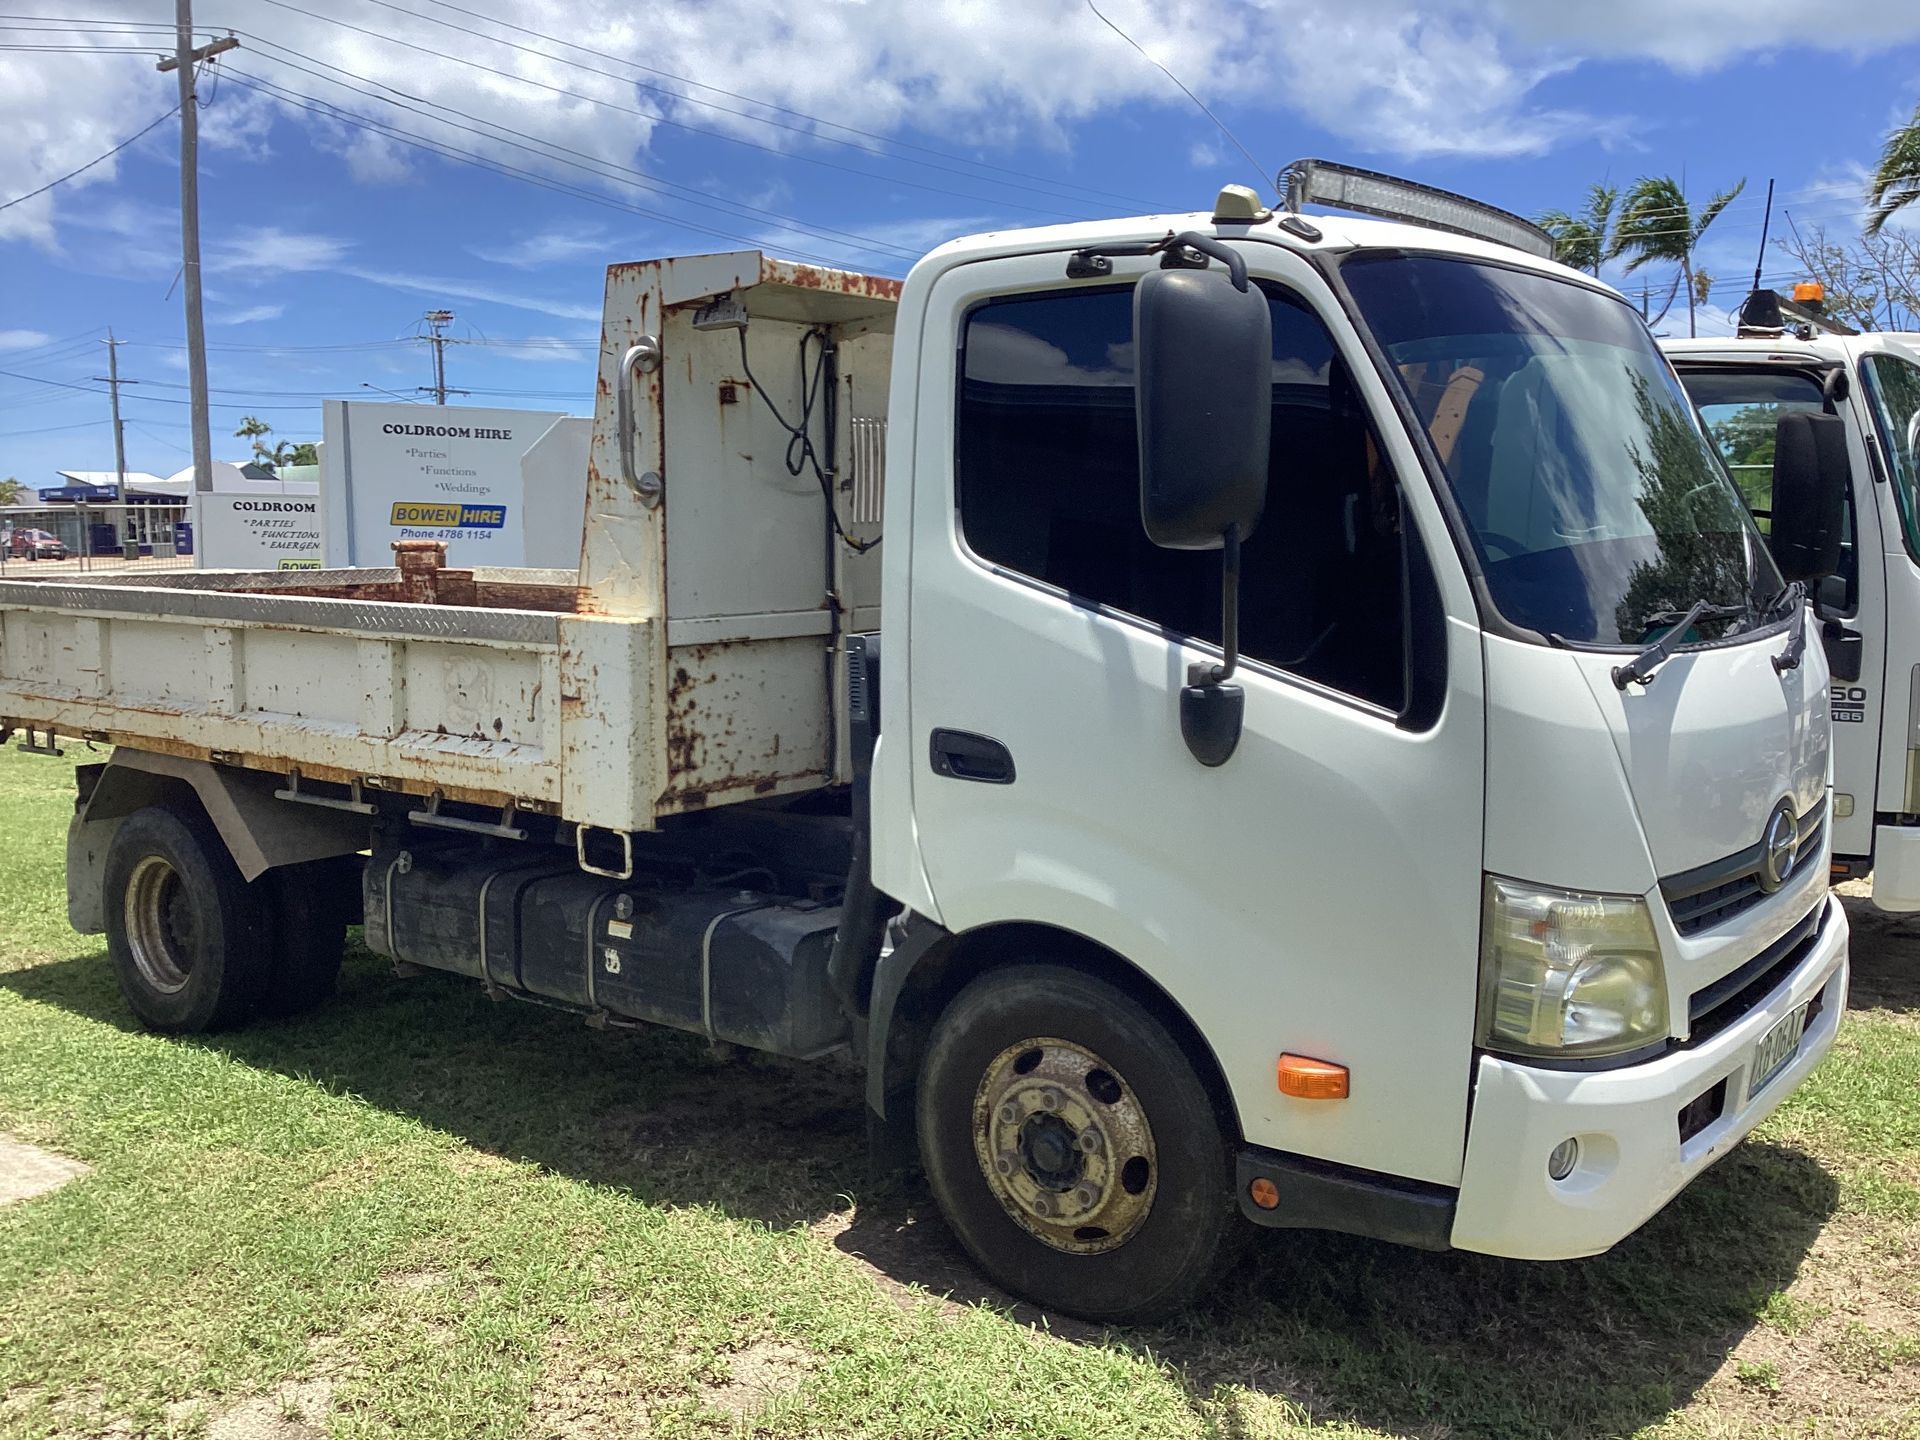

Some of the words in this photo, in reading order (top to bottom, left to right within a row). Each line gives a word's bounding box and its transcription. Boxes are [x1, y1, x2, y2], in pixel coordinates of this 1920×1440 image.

[383, 424, 471, 438] COLDROOM
[474, 428, 512, 440] HIRE
[233, 501, 316, 513] COLDROOM
[396, 508, 458, 522] BOWEN
[462, 509, 502, 523] HIRE
[400, 528, 435, 538] Phone
[437, 529, 464, 539] 4786
[467, 530, 492, 540] 1154
[281, 562, 320, 570] BOWE
